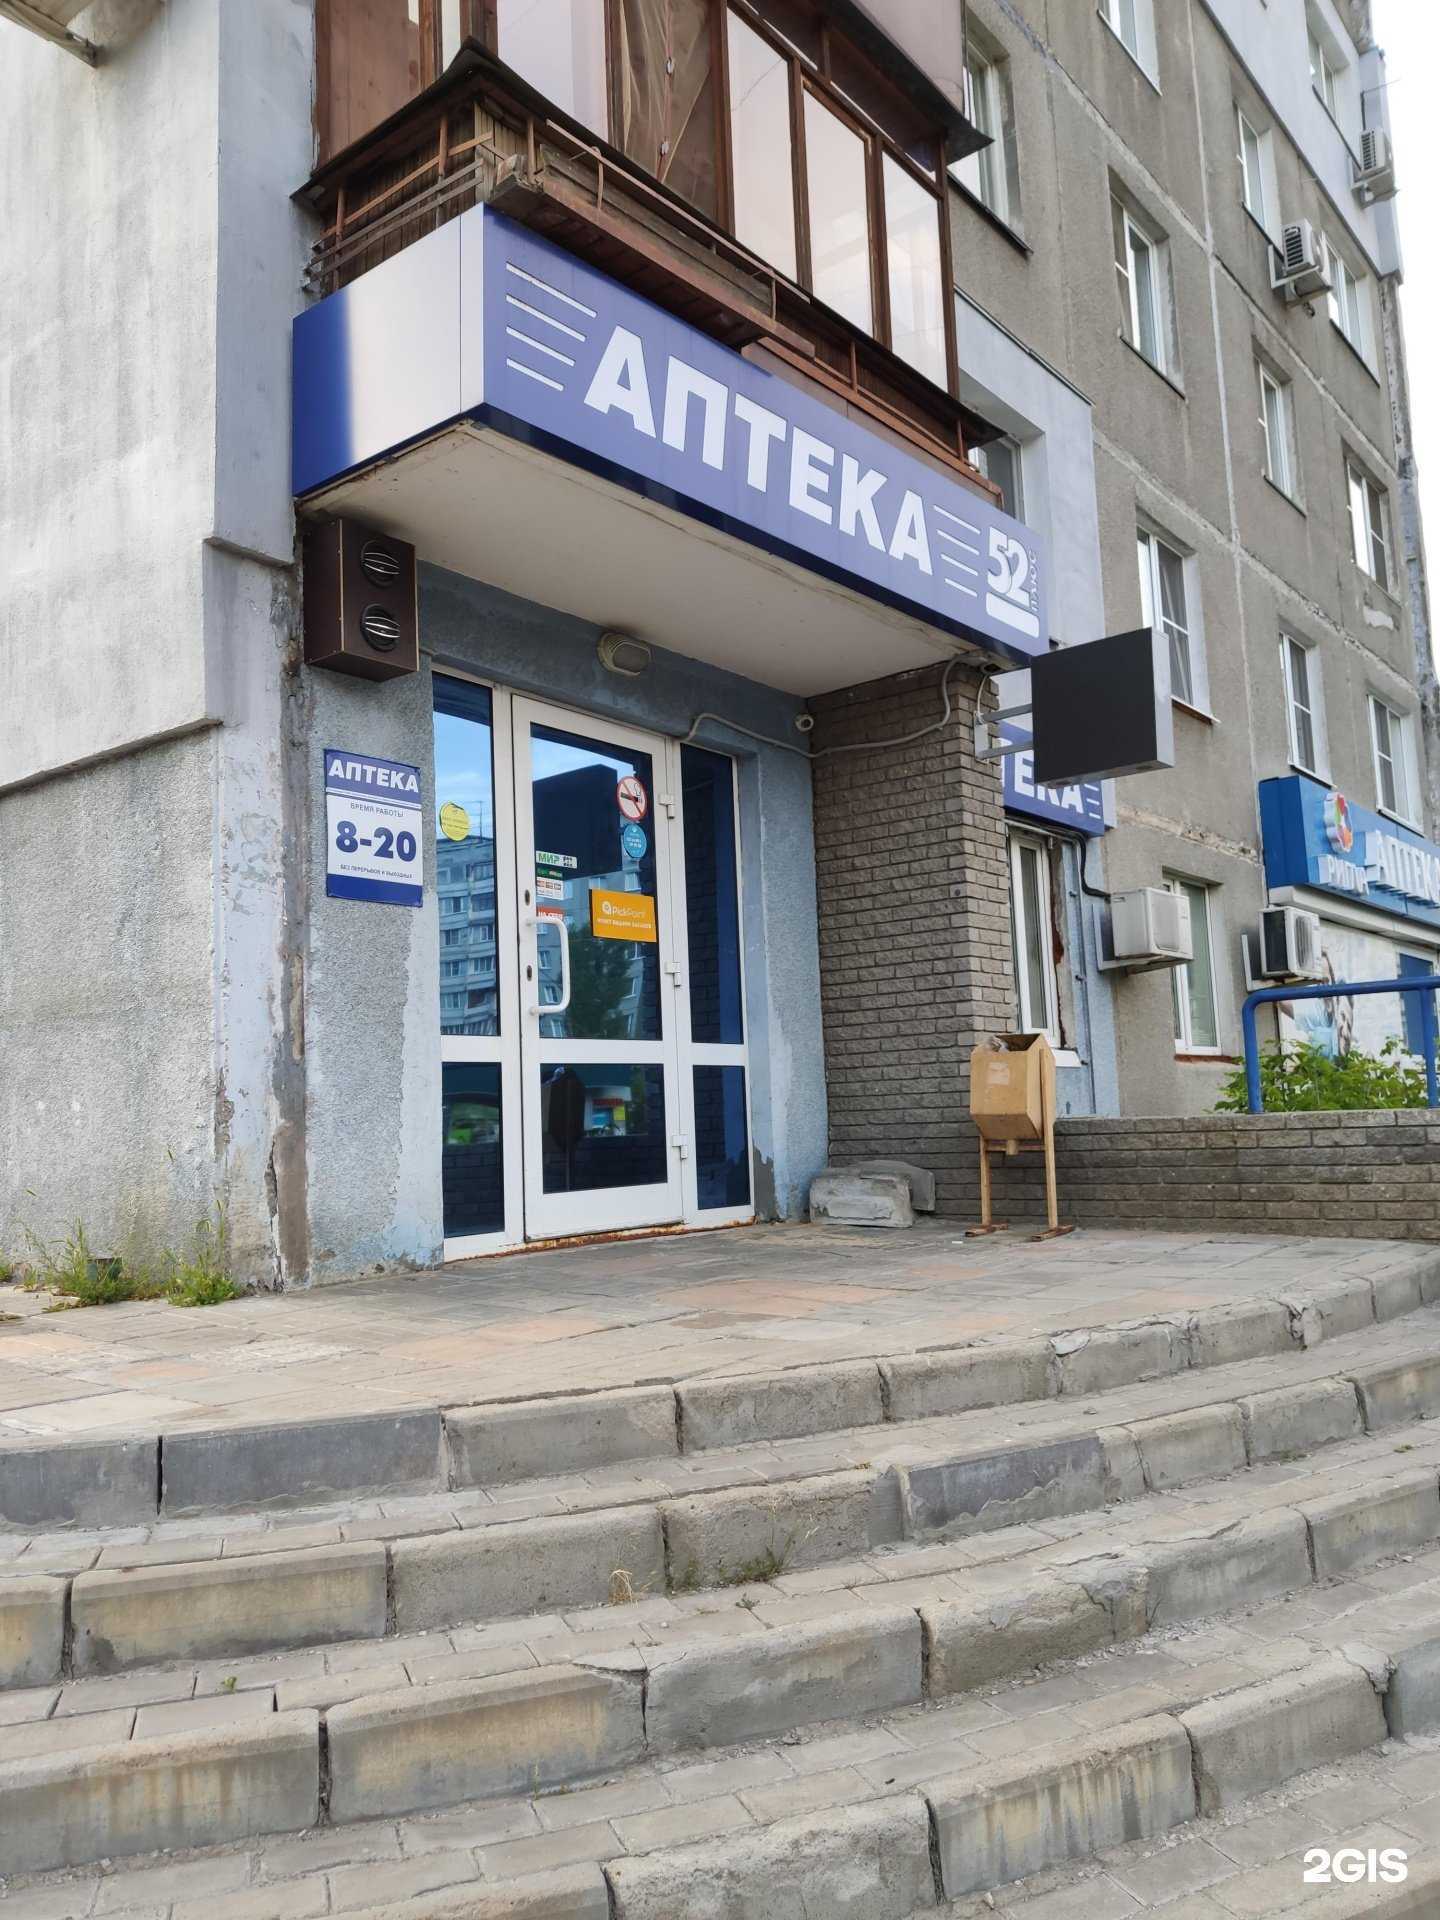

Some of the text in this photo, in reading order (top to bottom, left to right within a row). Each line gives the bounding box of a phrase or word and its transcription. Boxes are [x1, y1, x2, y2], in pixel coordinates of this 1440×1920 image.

[584, 325, 1030, 608] АПТЕКА 52
[328, 759, 419, 793] АПТЕКА
[350, 802, 404, 818] ВРЕМЯ РАБОТЫ
[336, 820, 417, 862] 8-20
